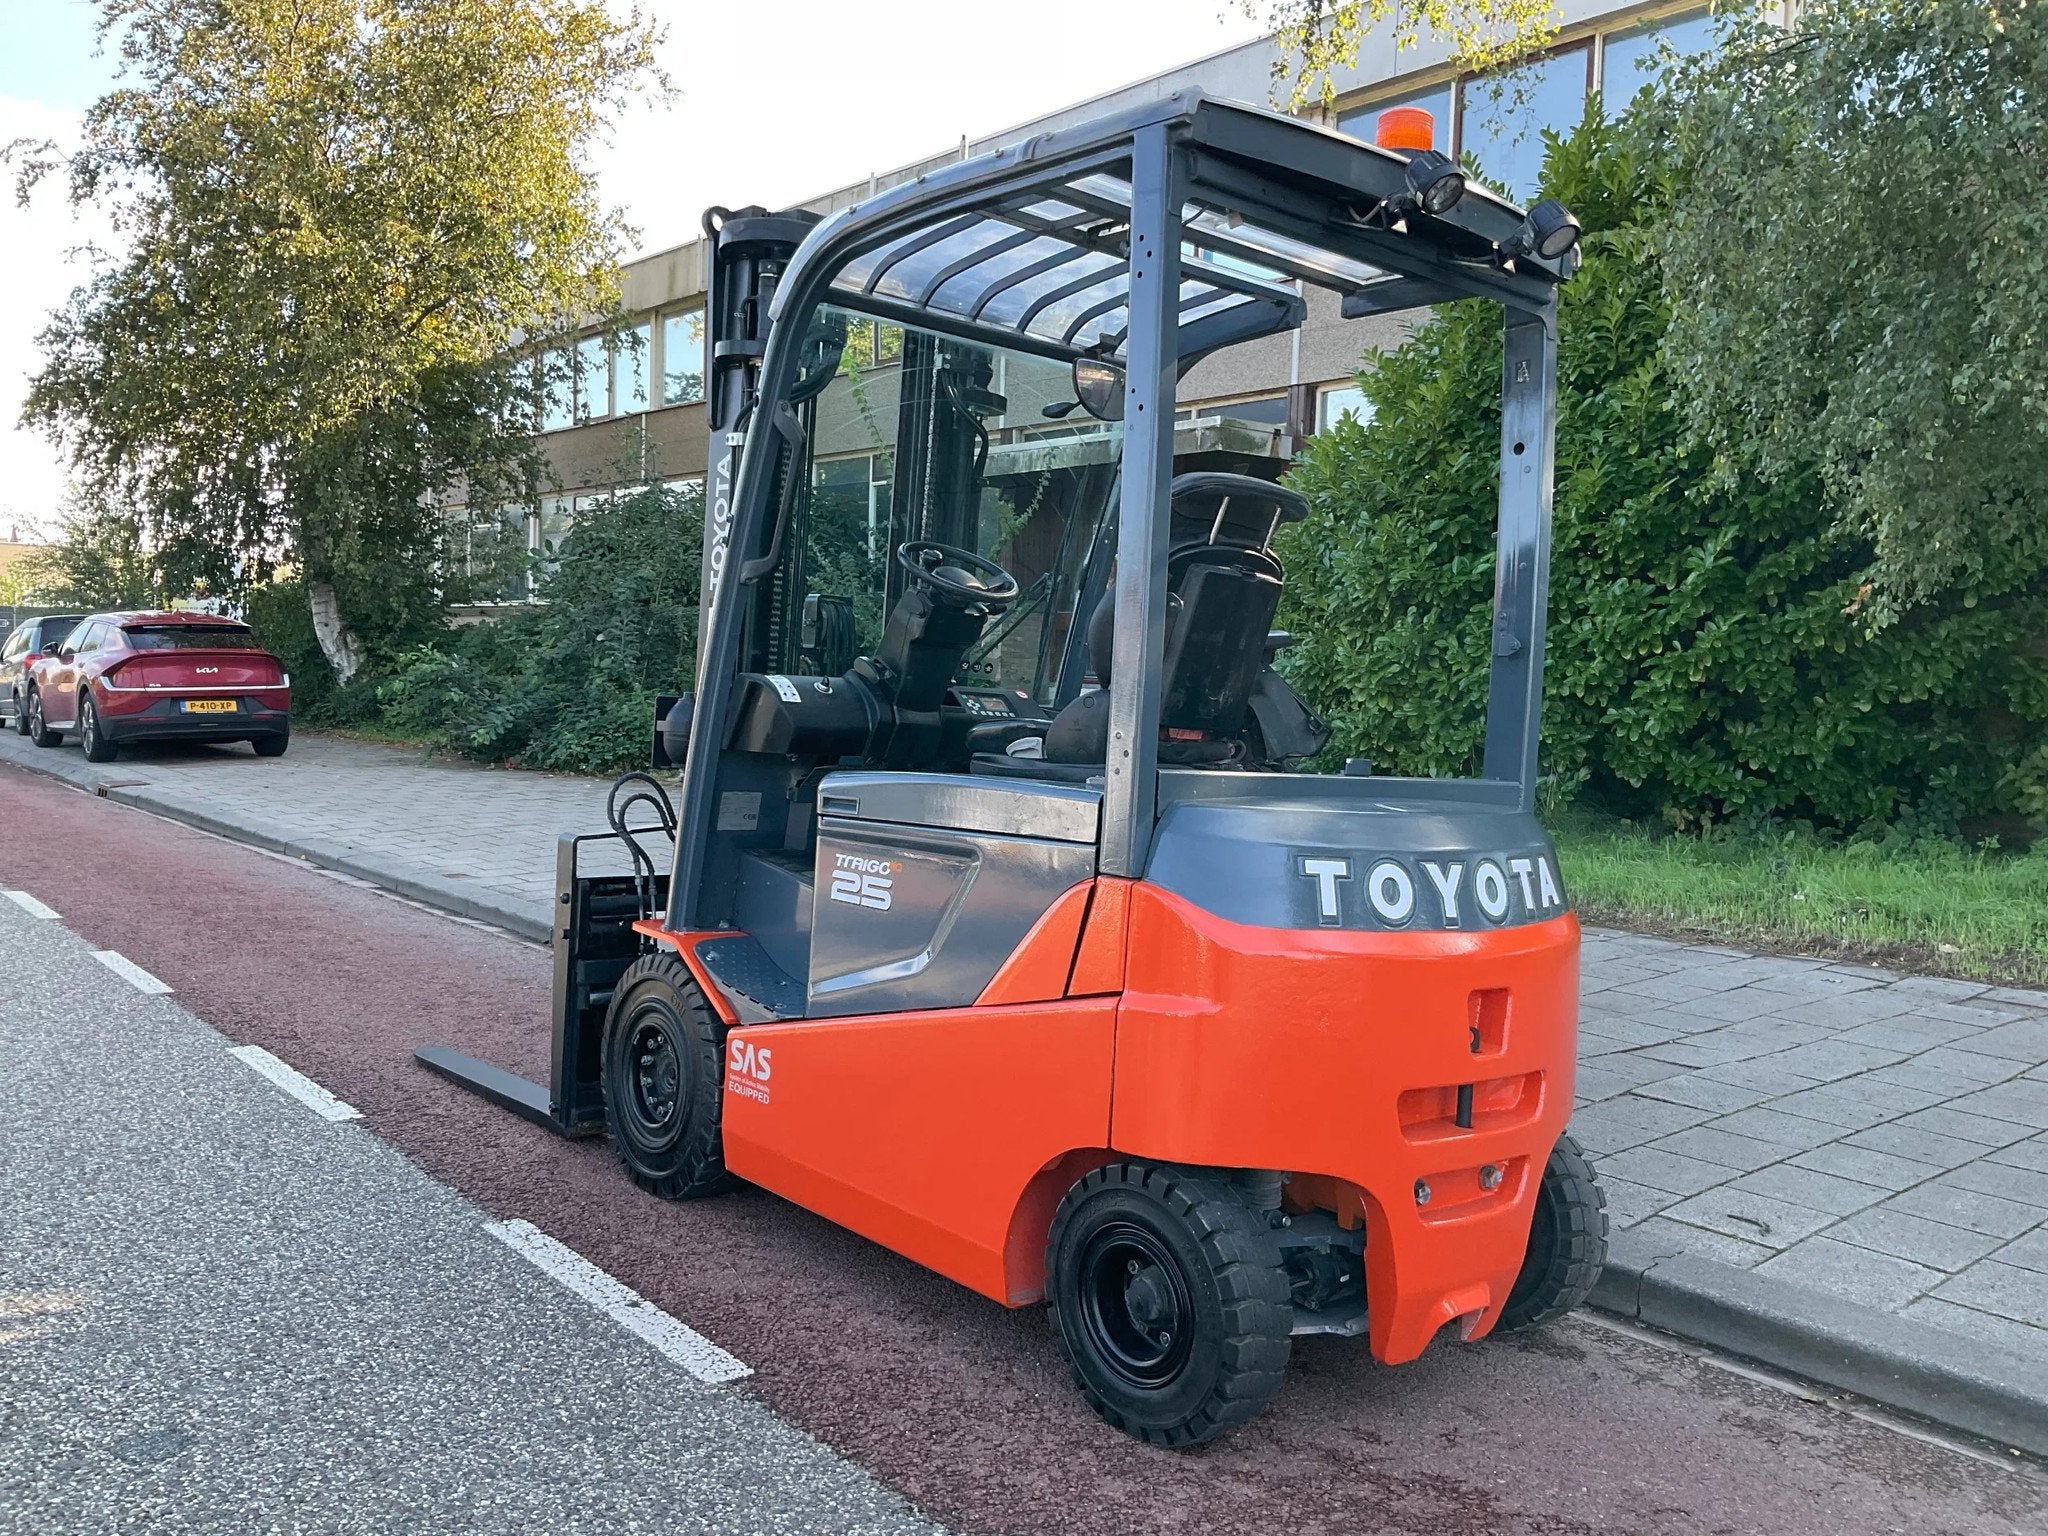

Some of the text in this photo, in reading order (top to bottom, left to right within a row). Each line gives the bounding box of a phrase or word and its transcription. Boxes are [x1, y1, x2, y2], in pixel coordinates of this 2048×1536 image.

[709, 453, 731, 591] TOYOTA
[190, 702, 232, 710] P-410-XP
[835, 853, 891, 875] TRAIGO
[831, 869, 893, 911] 25
[1303, 856, 1560, 922] TOYOTA
[730, 1039, 772, 1081] SAS
[729, 1081, 770, 1104] EQUIPPED
